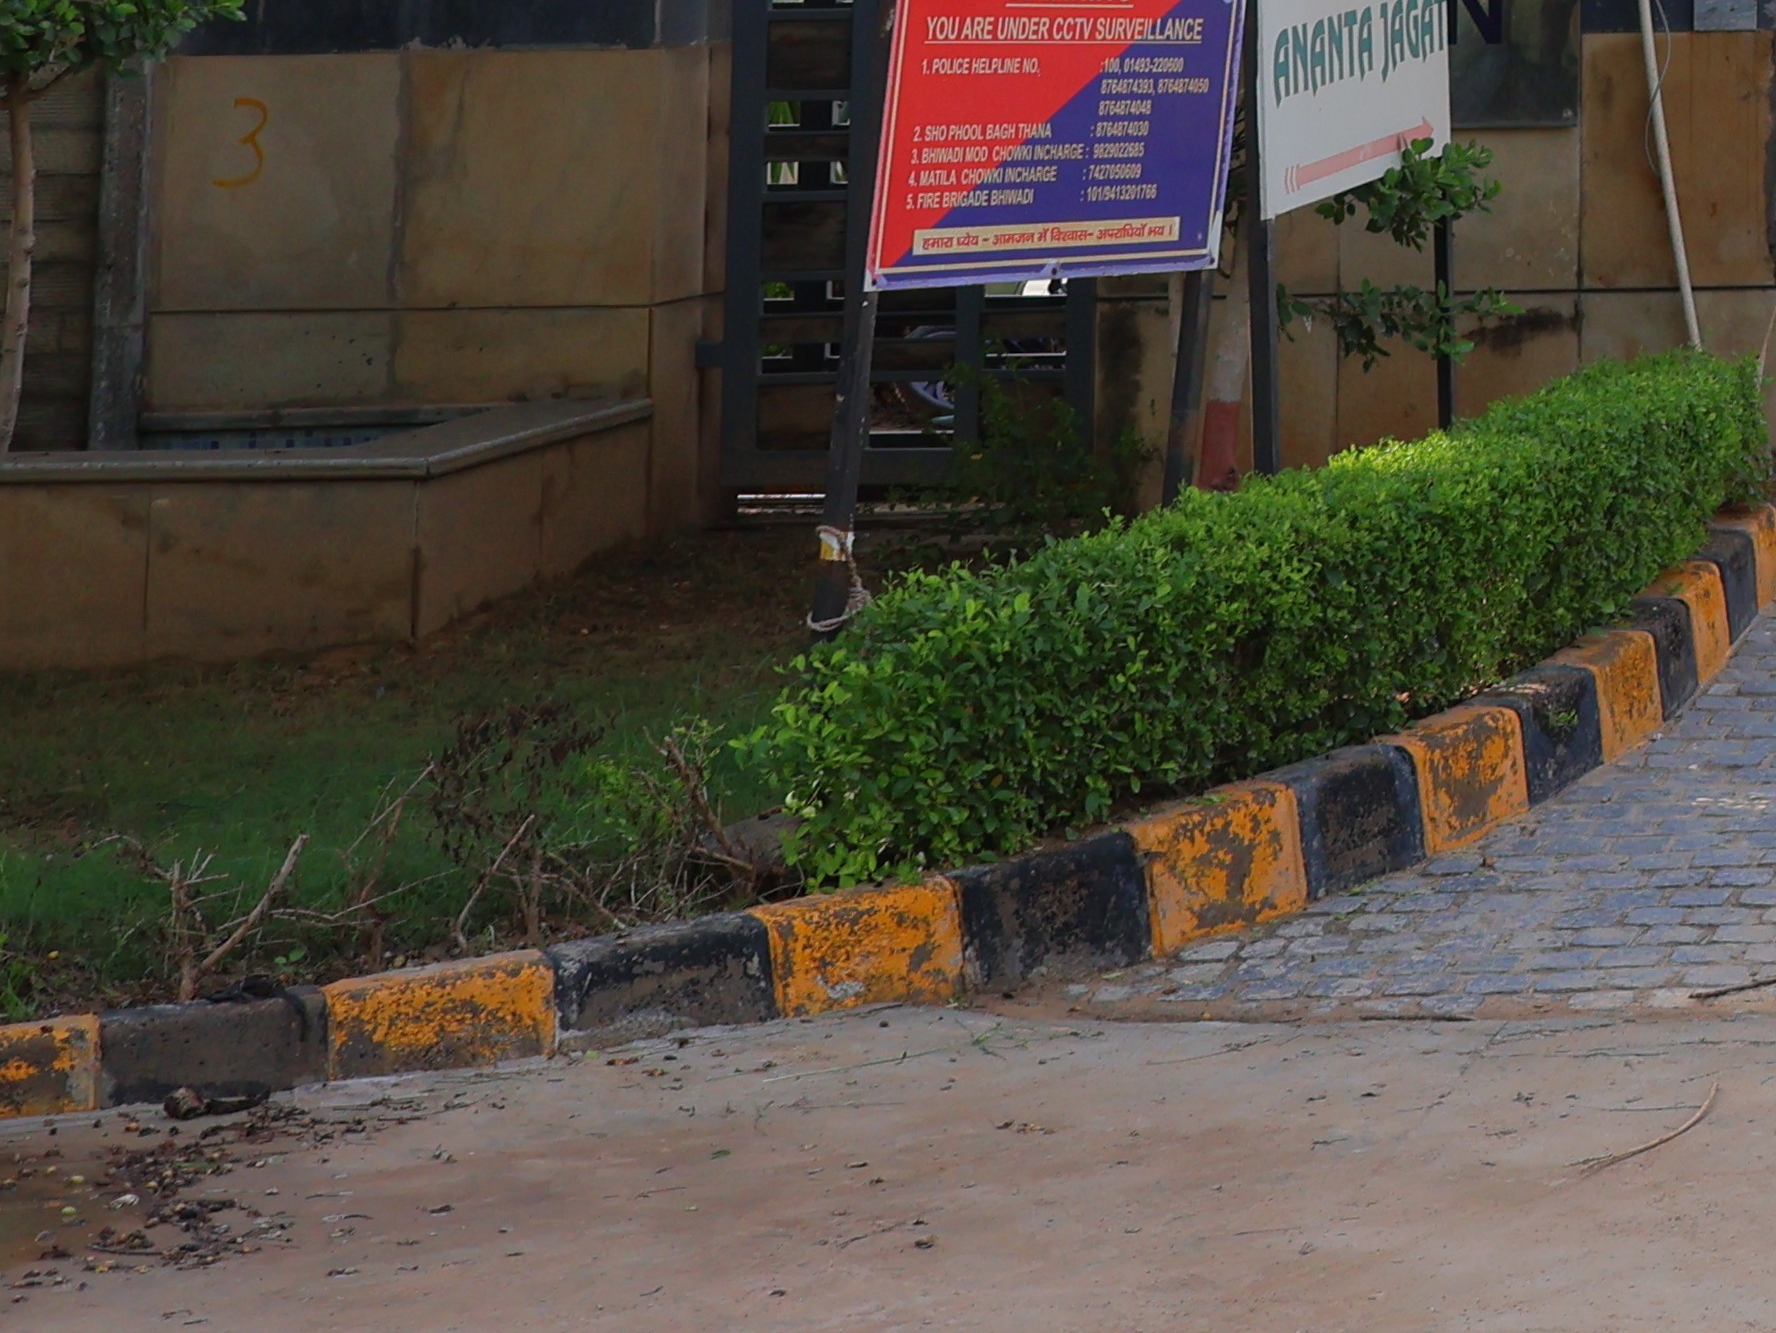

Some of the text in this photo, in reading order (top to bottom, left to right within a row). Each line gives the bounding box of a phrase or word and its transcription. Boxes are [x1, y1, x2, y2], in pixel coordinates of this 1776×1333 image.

[927, 16, 1204, 40] YOU ARE UNDER CCTV SURVEILLANCE
[922, 59, 930, 75] 1.
[932, 58, 971, 75] POLICE
[972, 58, 1021, 74] HELPLINE
[1273, 6, 1374, 108] ANANTA
[212, 96, 269, 189] 3
[913, 126, 922, 142] 2.
[925, 125, 948, 141] SHO
[949, 124, 984, 141] PHOOL
[985, 124, 1015, 140] BAGH
[1017, 123, 1052, 139] THANA
[911, 148, 919, 164] 3.
[921, 147, 963, 164] BHIWADI
[964, 146, 988, 162] MOD
[992, 145, 1032, 162] CHOWKI
[1034, 143, 1085, 161] INCHARGE
[908, 170, 917, 186] 4.
[919, 169, 957, 186] MATILA
[961, 168, 1004, 185] CHOWKI
[1004, 166, 1058, 183] INCHARGE
[906, 193, 915, 209] 5.
[917, 192, 941, 209] FIRE
[942, 190, 989, 207] BRIGADE
[990, 188, 1034, 205] BHIWADI
